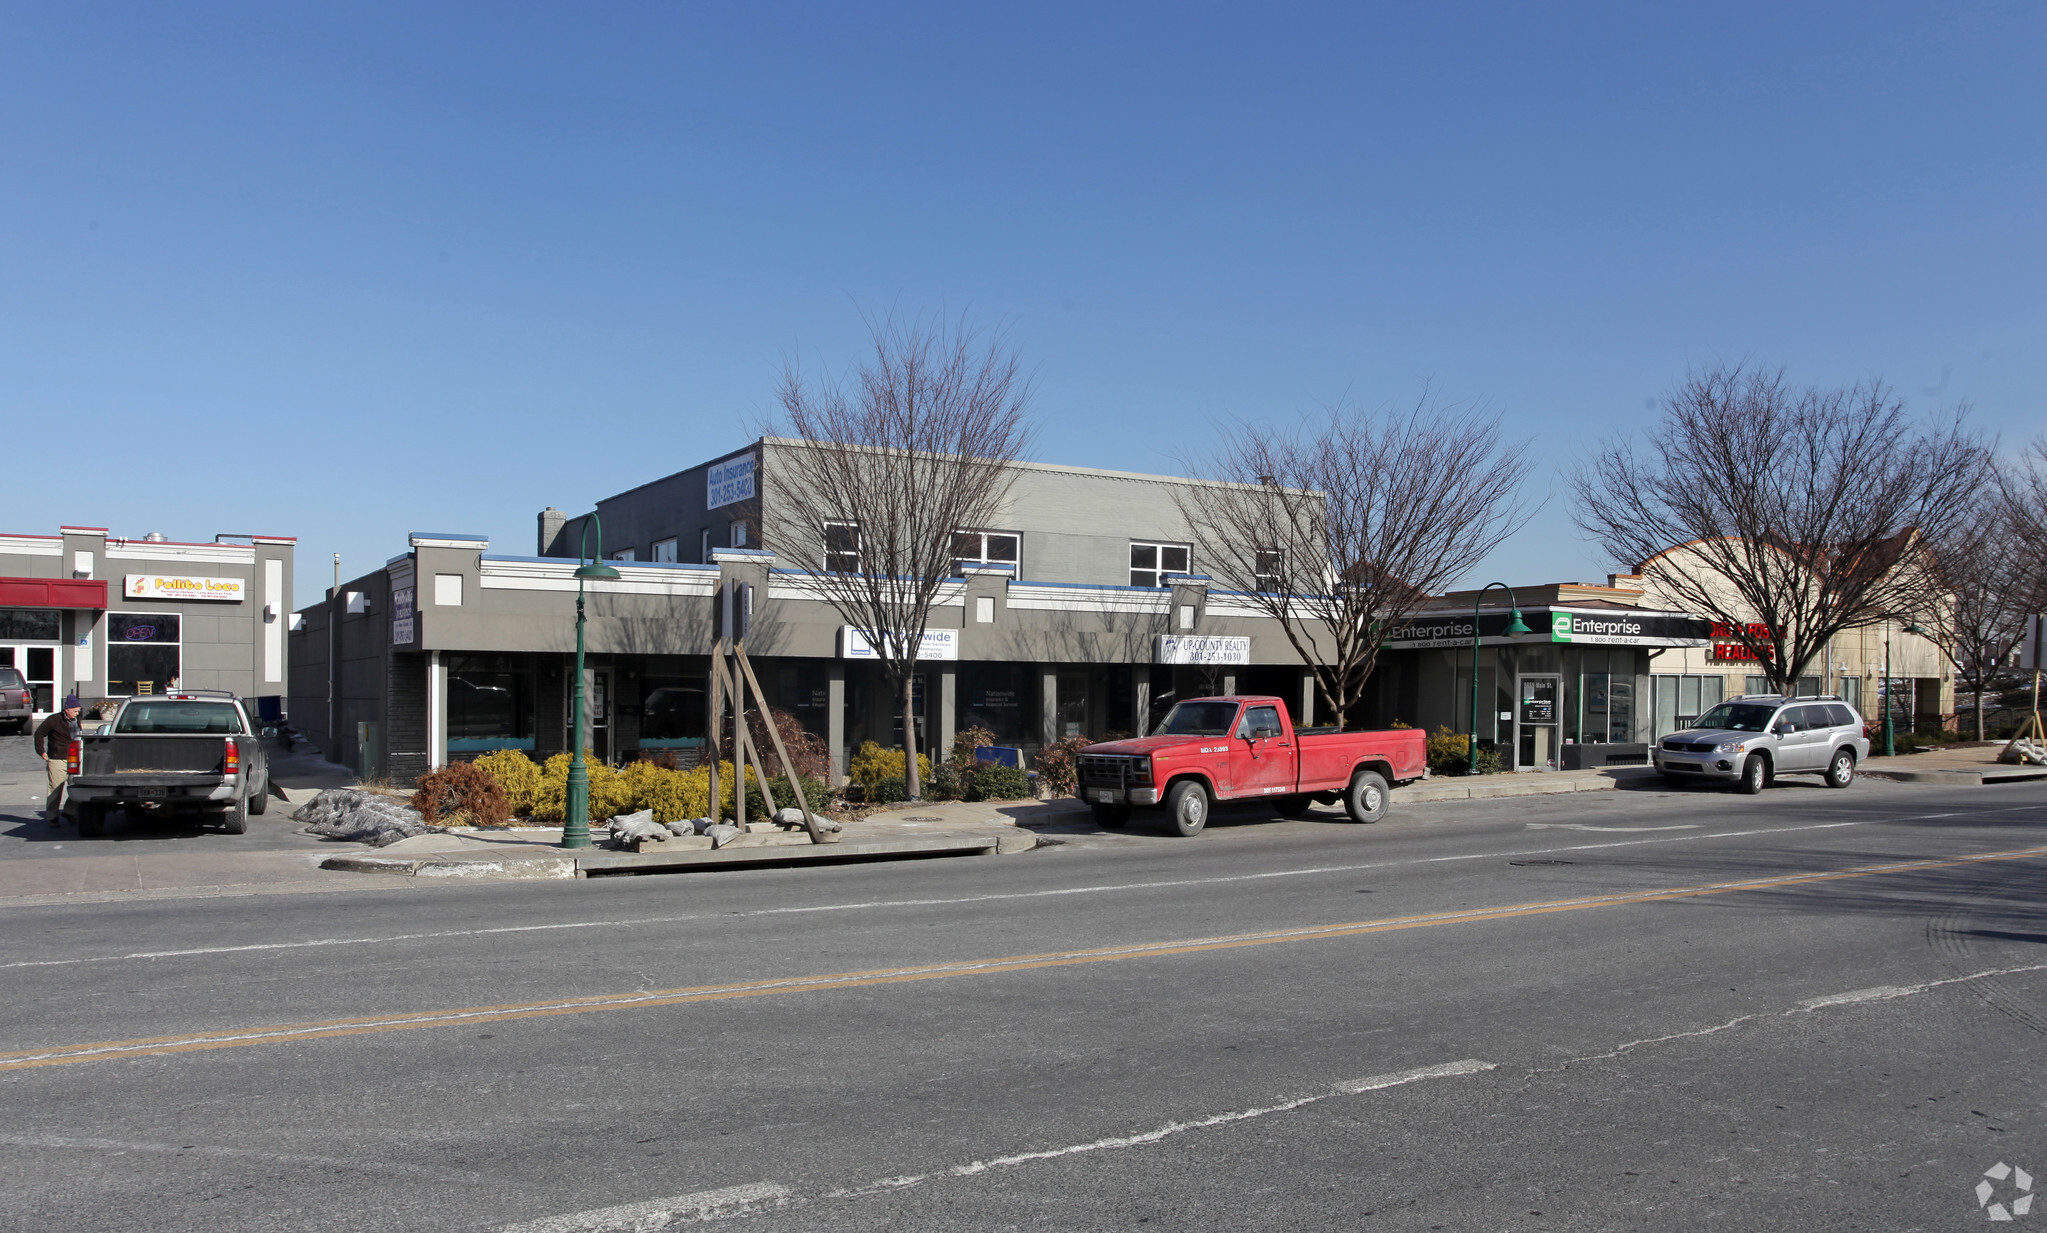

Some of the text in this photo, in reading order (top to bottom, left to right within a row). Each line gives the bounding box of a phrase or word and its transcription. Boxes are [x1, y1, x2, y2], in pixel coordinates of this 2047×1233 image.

[709, 460, 754, 487] Auto Insurance
[205, 579, 239, 591] Loco
[126, 628, 154, 638] OPEN
[1392, 621, 1473, 639] Enterprise
[1573, 618, 1641, 636] Enterprise
[1183, 640, 1247, 651] UP-COUNTY REALTY
[1190, 652, 1241, 661] 301-253-1030
